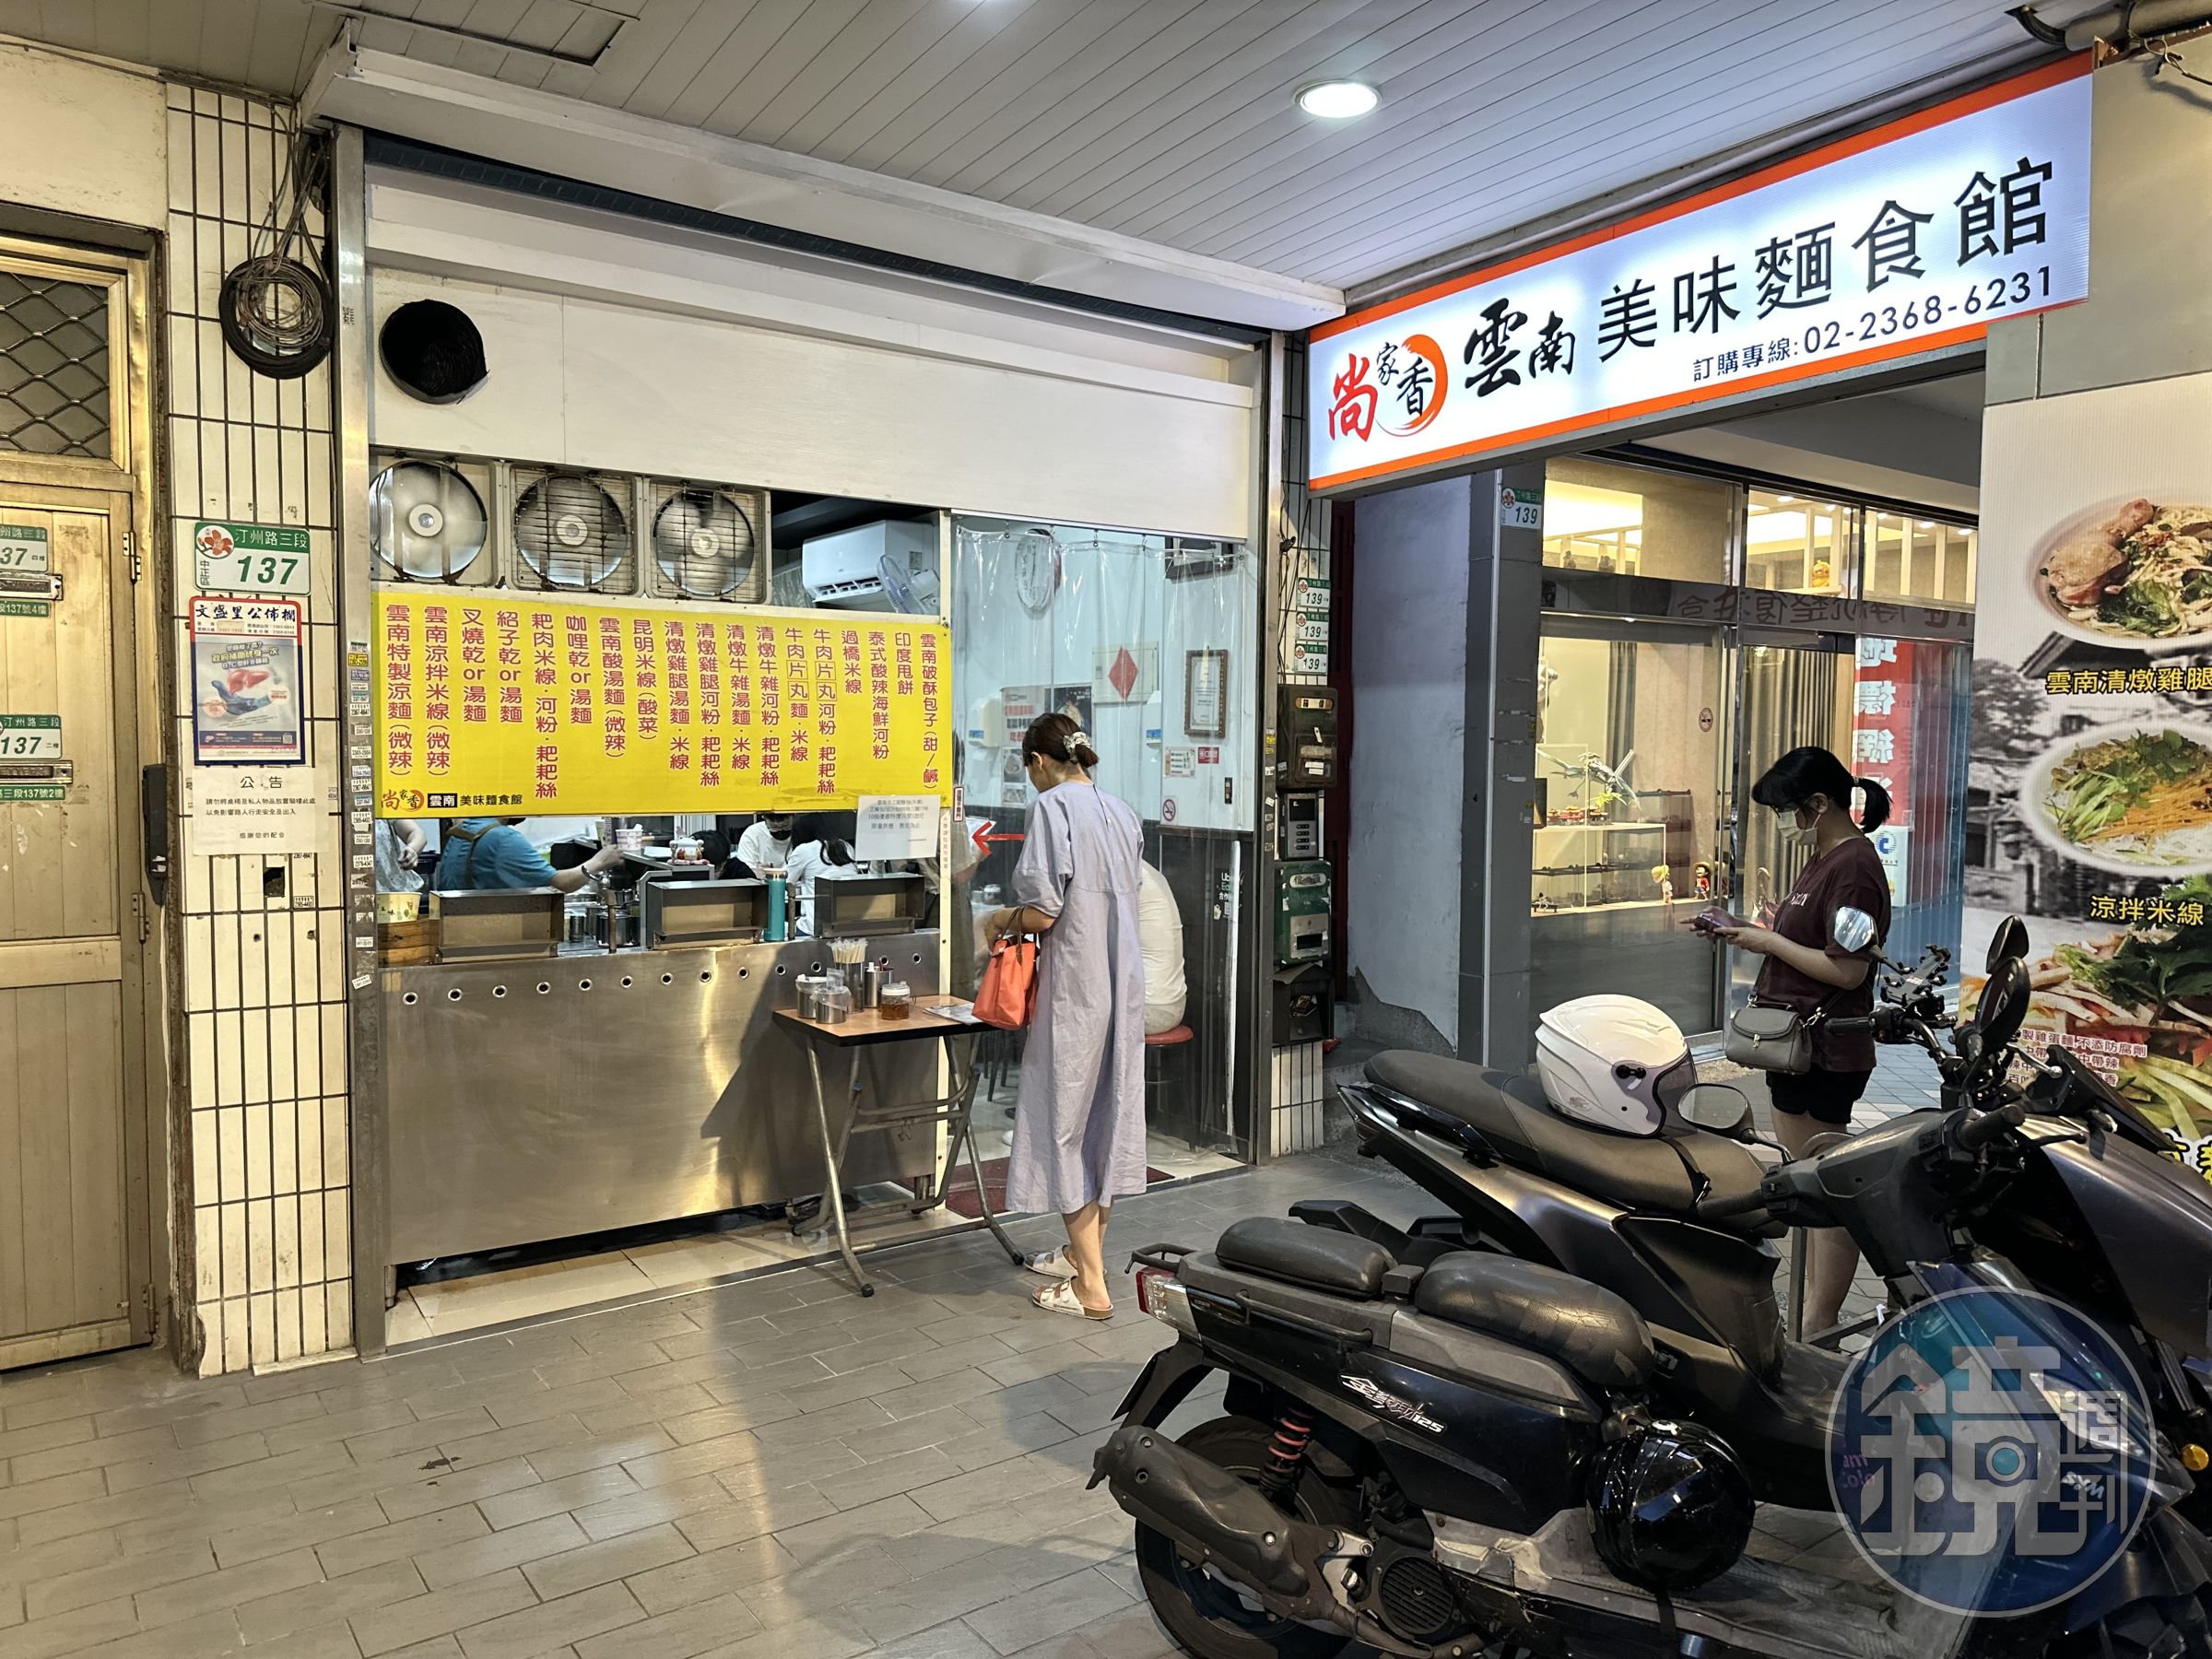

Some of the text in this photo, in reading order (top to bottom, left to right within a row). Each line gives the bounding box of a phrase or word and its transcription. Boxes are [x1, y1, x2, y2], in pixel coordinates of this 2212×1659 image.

[1464, 298, 1576, 396] 雲南
[1598, 158, 2053, 362] 美味麵食館
[1515, 507, 1538, 524] 139
[235, 528, 307, 548] 汀州路三段
[200, 559, 210, 586] 中正區
[238, 556, 299, 585] 137
[195, 605, 296, 622] 文盛里公佈欄
[1306, 593, 1323, 605] 139
[1304, 625, 1322, 638] 139
[462, 608, 487, 723] 叉燒乾or湯麵
[496, 610, 523, 724] 紹子乾or湯麵
[566, 615, 593, 724] 咖哩乾or湯麵
[841, 629, 862, 694] 過橋米線
[895, 632, 913, 695] 印度甩餅
[386, 605, 413, 776] 雲南特製涼麵(微辣)
[424, 606, 451, 776] 雲南涼拌米線(微辣)
[599, 618, 626, 758] 雲南酸湯麵(微辣)
[633, 619, 658, 740] 昆明米線(酸菜)
[868, 631, 889, 759] 泰式酸辣海鮮河粉
[4, 717, 60, 727] 汀州路三段
[1, 736, 41, 755] 137
[0, 788, 64, 799] 三段137號2樓
[240, 776, 283, 789] 公告
[429, 794, 456, 807] 雲南
[460, 794, 523, 806] 美味麵食館
[2090, 896, 2204, 925] 涼拌米線
